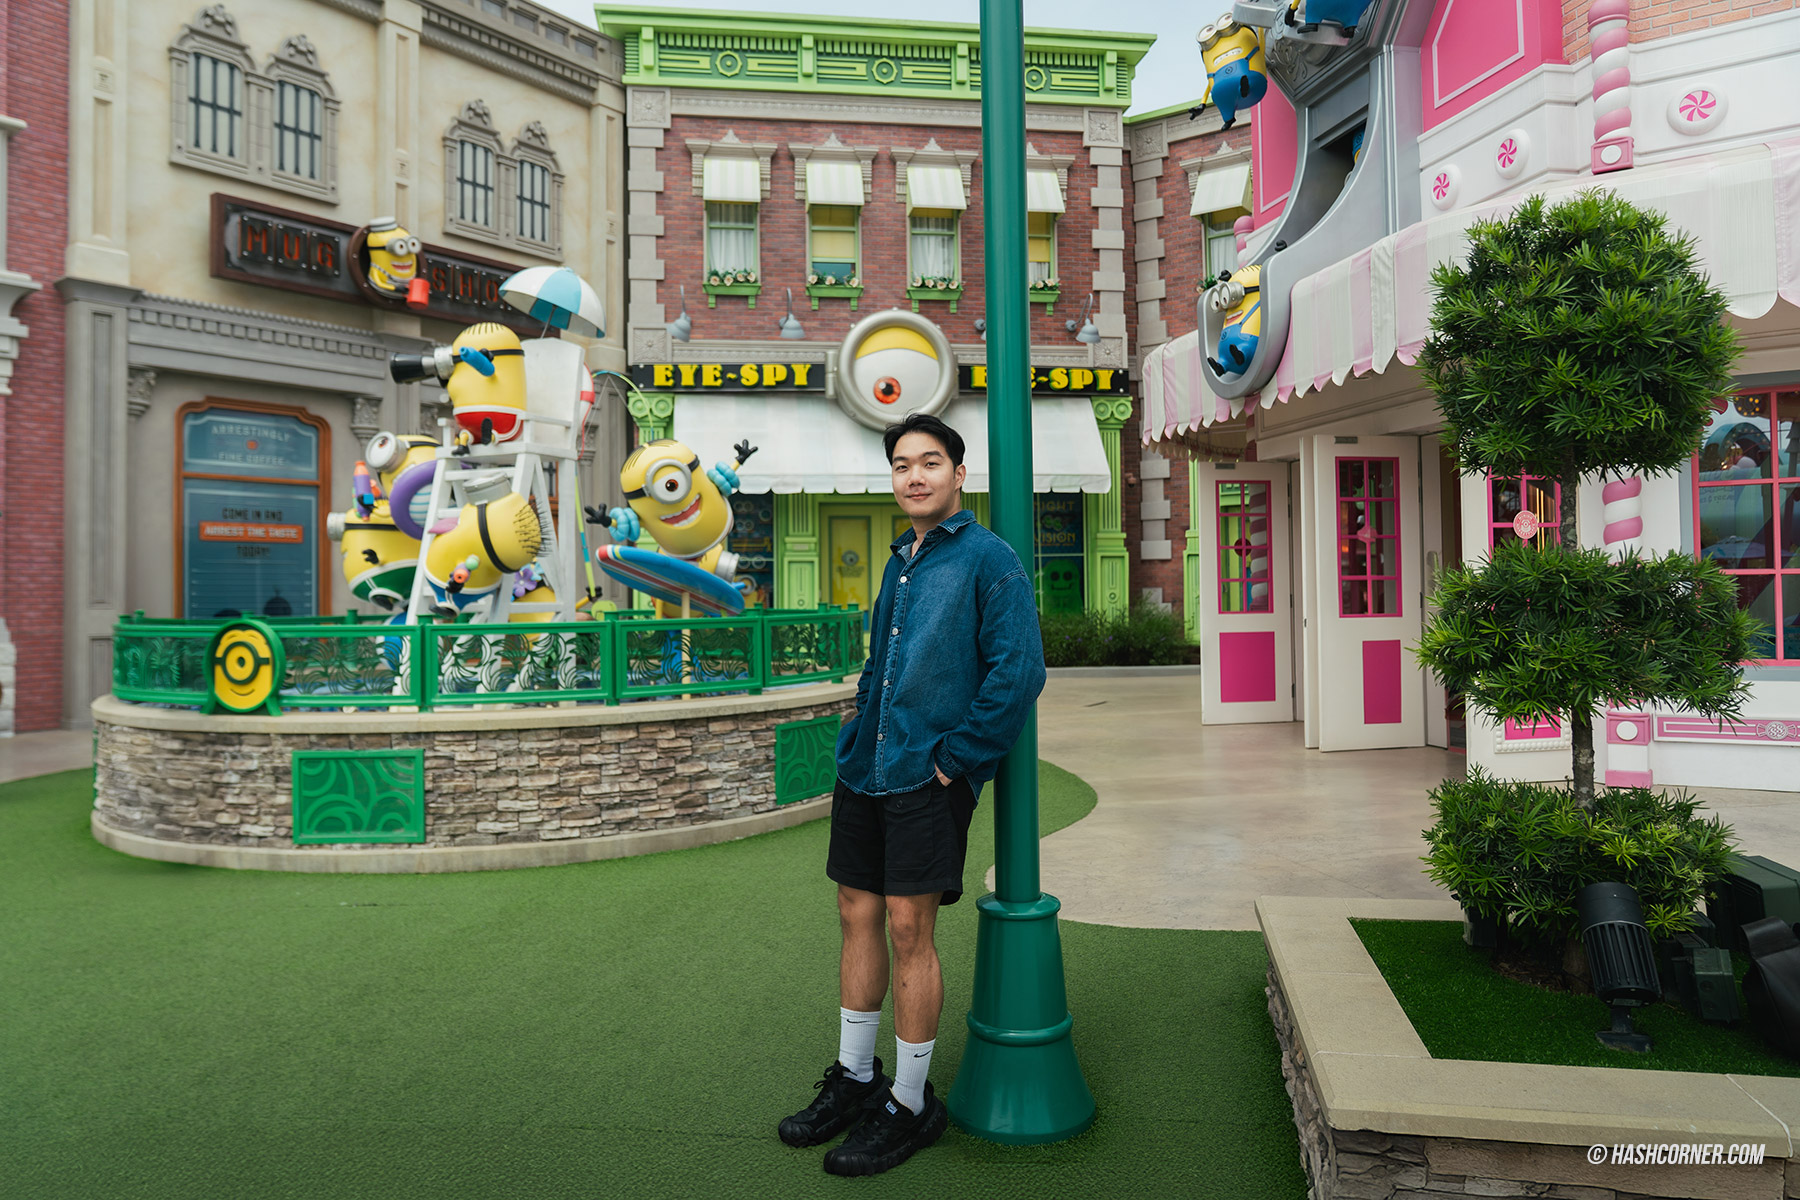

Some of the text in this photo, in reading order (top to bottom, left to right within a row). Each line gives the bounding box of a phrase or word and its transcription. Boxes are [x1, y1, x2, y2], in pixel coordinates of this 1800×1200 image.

[247, 225, 499, 303] MUG SHO
[653, 364, 812, 388] EYE-SPY
[971, 365, 1115, 391] E-SPY
[211, 424, 290, 442] ARRESTINGLY
[247, 526, 266, 538] THE
